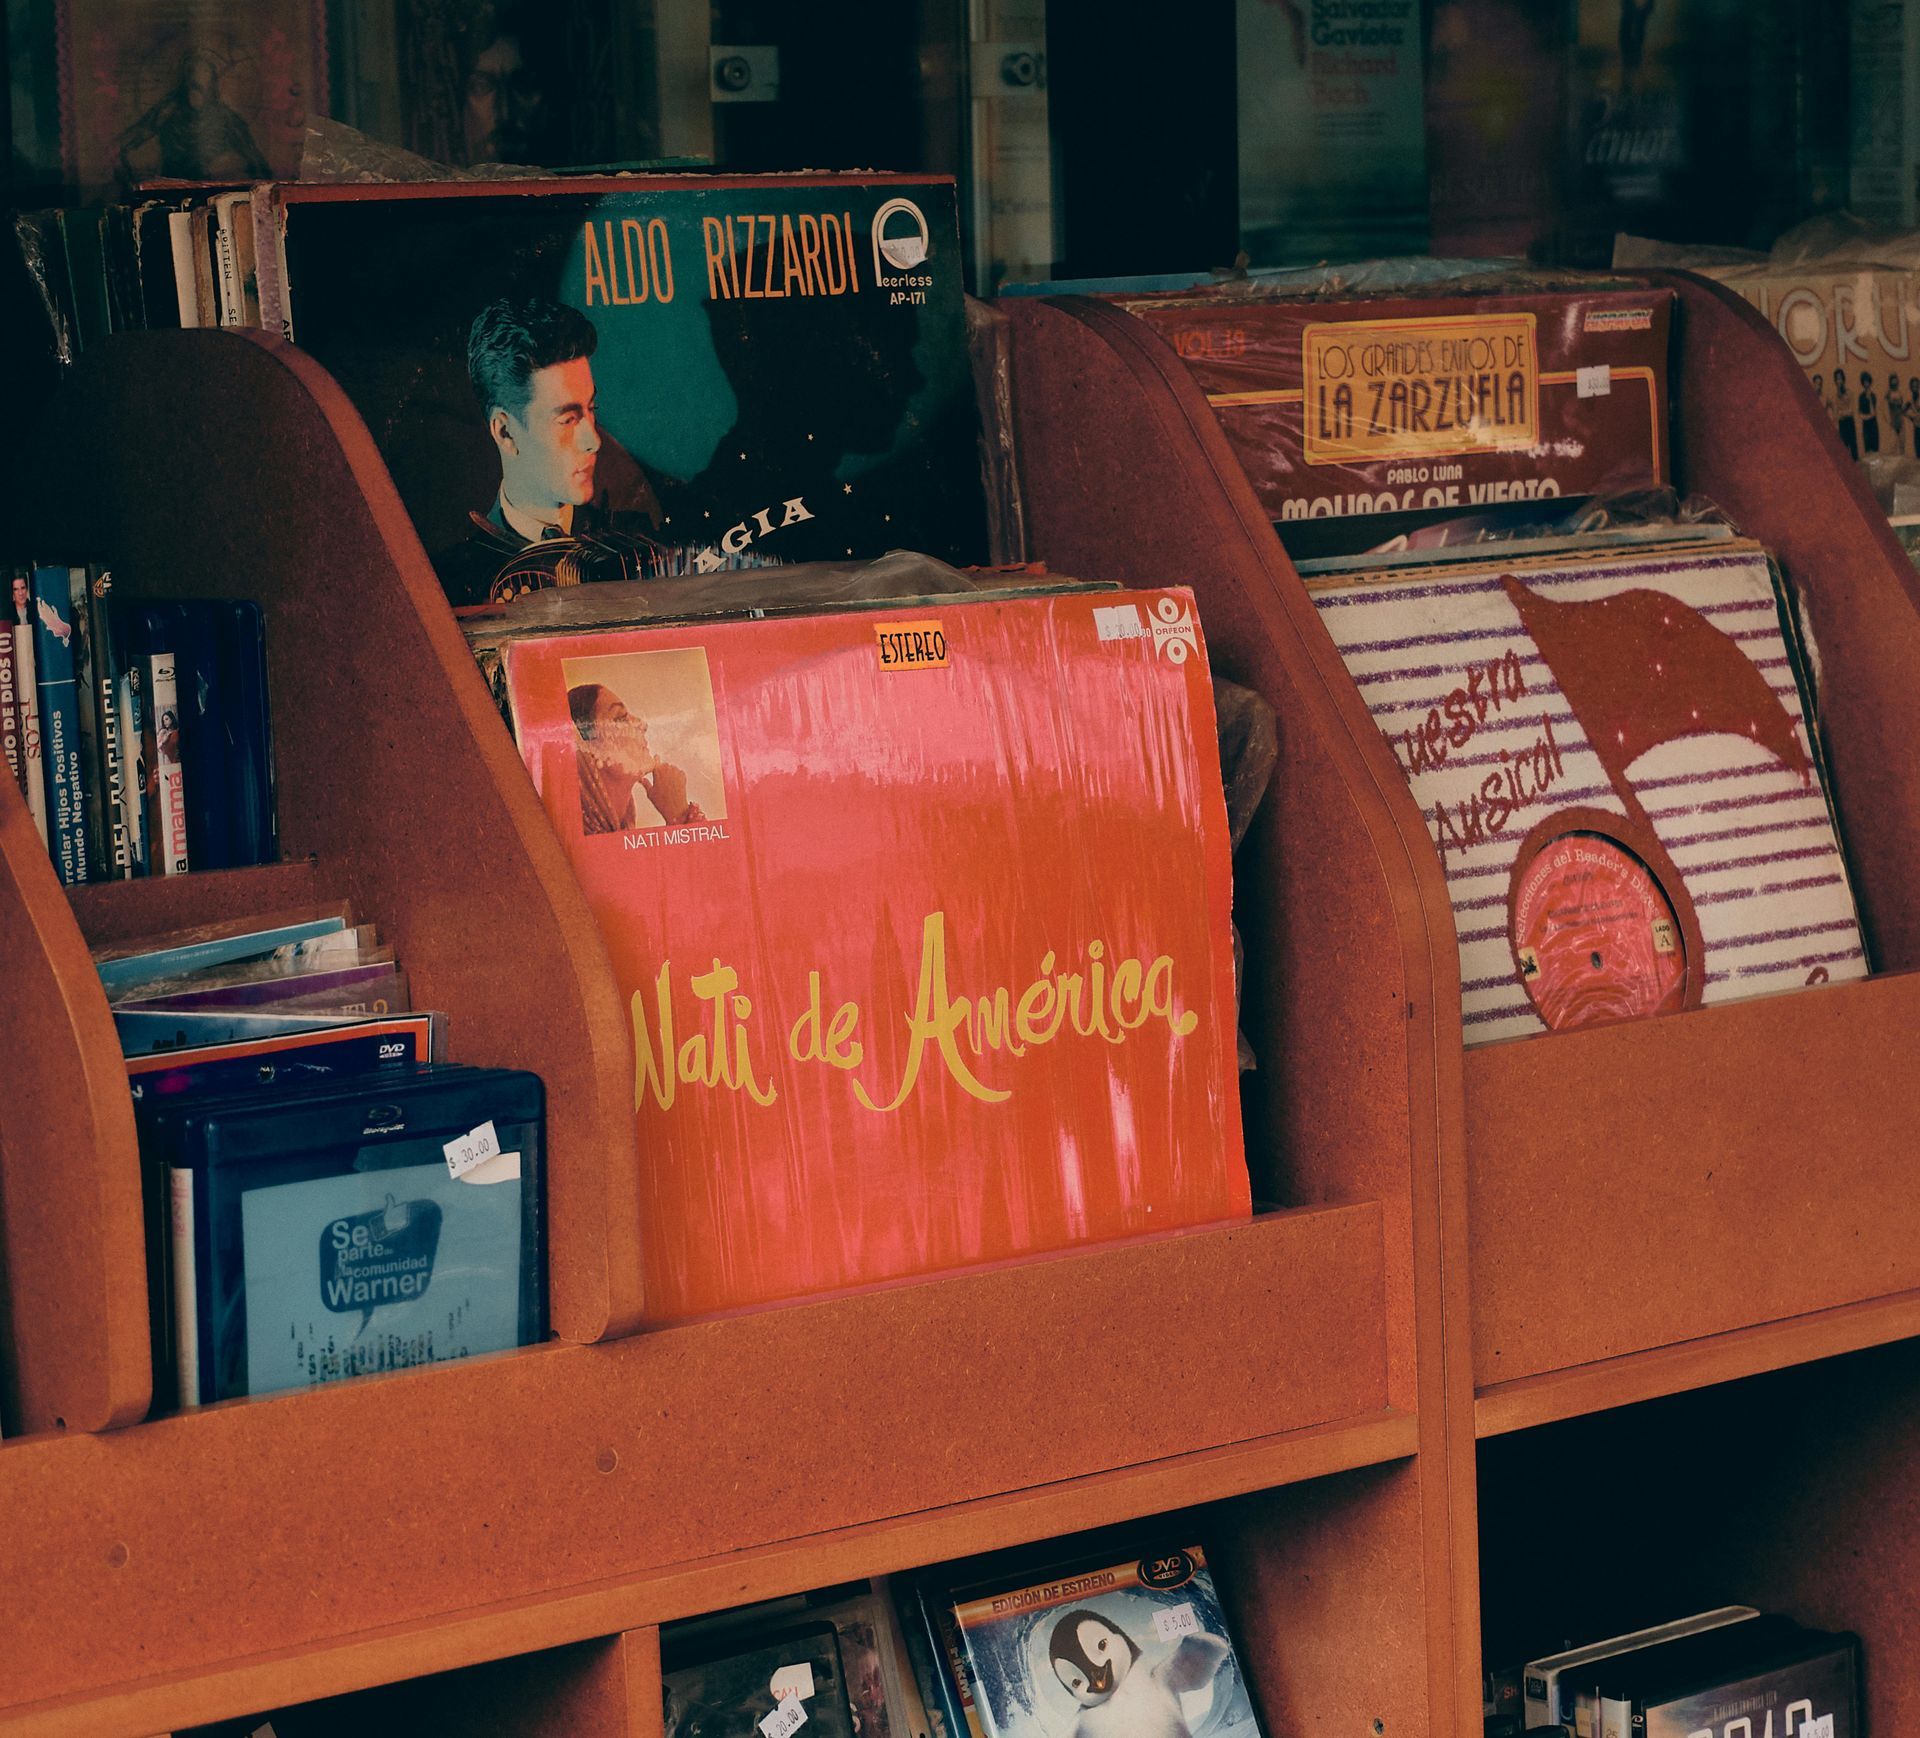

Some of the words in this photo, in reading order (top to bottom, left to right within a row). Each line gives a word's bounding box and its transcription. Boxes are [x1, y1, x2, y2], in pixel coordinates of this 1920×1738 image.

[585, 218, 674, 306] ALDO
[703, 212, 860, 300] RIZZARDI
[890, 291, 927, 305] AP-171
[1738, 281, 1920, 368] ORU
[1317, 345, 1355, 381] LOS
[1361, 340, 1435, 377] GRANDES
[1504, 335, 1525, 368] DE
[1318, 384, 1354, 440] LA
[1366, 371, 1526, 436] ZARZUELA
[1386, 467, 1430, 486] PABLO
[1432, 464, 1463, 481] LUNA
[680, 497, 816, 574] AGIA
[879, 630, 946, 664] ESTEREO
[1155, 626, 1192, 636] ORFEON
[1, 657, 14, 703] DIOS
[2, 706, 16, 731] DE
[53, 710, 68, 785] Positivos
[69, 751, 83, 824] Negativo
[57, 787, 71, 829] Hijos
[71, 828, 87, 882] Mundo
[623, 832, 660, 851] NATI
[664, 825, 730, 846] MISTRAL
[1515, 863, 1553, 945] Selecciones
[1553, 850, 1573, 869] del
[1574, 848, 1629, 878] Reader's
[1661, 934, 1671, 947] A
[631, 957, 778, 1115] Nati
[789, 971, 864, 1070] de
[852, 911, 1199, 1112] América
[379, 1043, 405, 1055] DVD
[449, 1156, 457, 1169] $
[461, 1137, 491, 1164] 30.00
[331, 1220, 369, 1250] Se
[337, 1241, 384, 1262] parte
[353, 1254, 428, 1278] comunidad
[327, 1271, 428, 1306] Warner
[1151, 1556, 1181, 1573] DVD
[991, 1589, 1041, 1614] EDICIÓN
[1043, 1586, 1060, 1601] DE
[1062, 1572, 1116, 1597] ESTRENO
[1163, 1619, 1170, 1632] $
[1171, 1613, 1192, 1631] 5.00
[775, 1708, 800, 1737] 20.00
